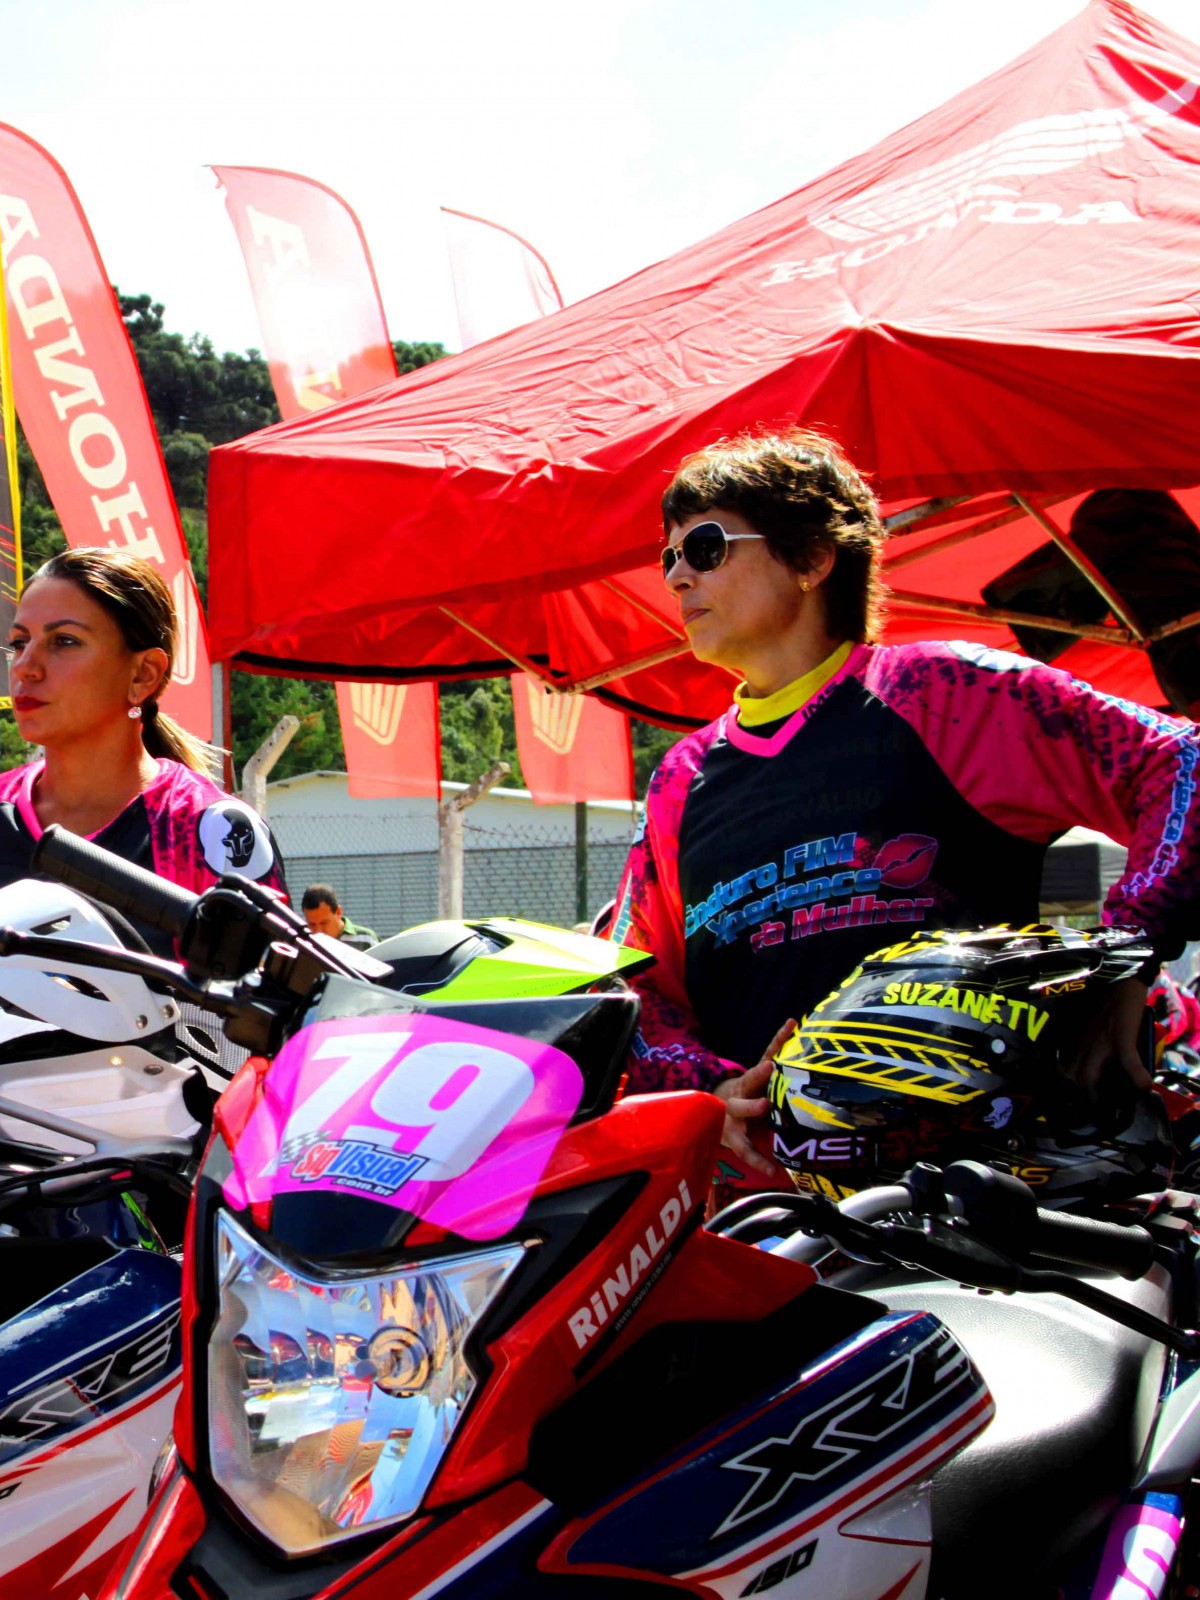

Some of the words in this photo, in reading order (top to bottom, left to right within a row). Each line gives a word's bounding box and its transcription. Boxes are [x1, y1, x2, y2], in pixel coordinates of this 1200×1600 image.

[759, 198, 1144, 288] HONDA
[684, 862, 778, 940] Enduro
[783, 831, 858, 879] FIM
[704, 867, 882, 950] Xperience
[791, 894, 934, 940] Mulher
[263, 1030, 536, 1183] 79
[773, 1132, 866, 1161] MS
[709, 1322, 973, 1541] XRE
